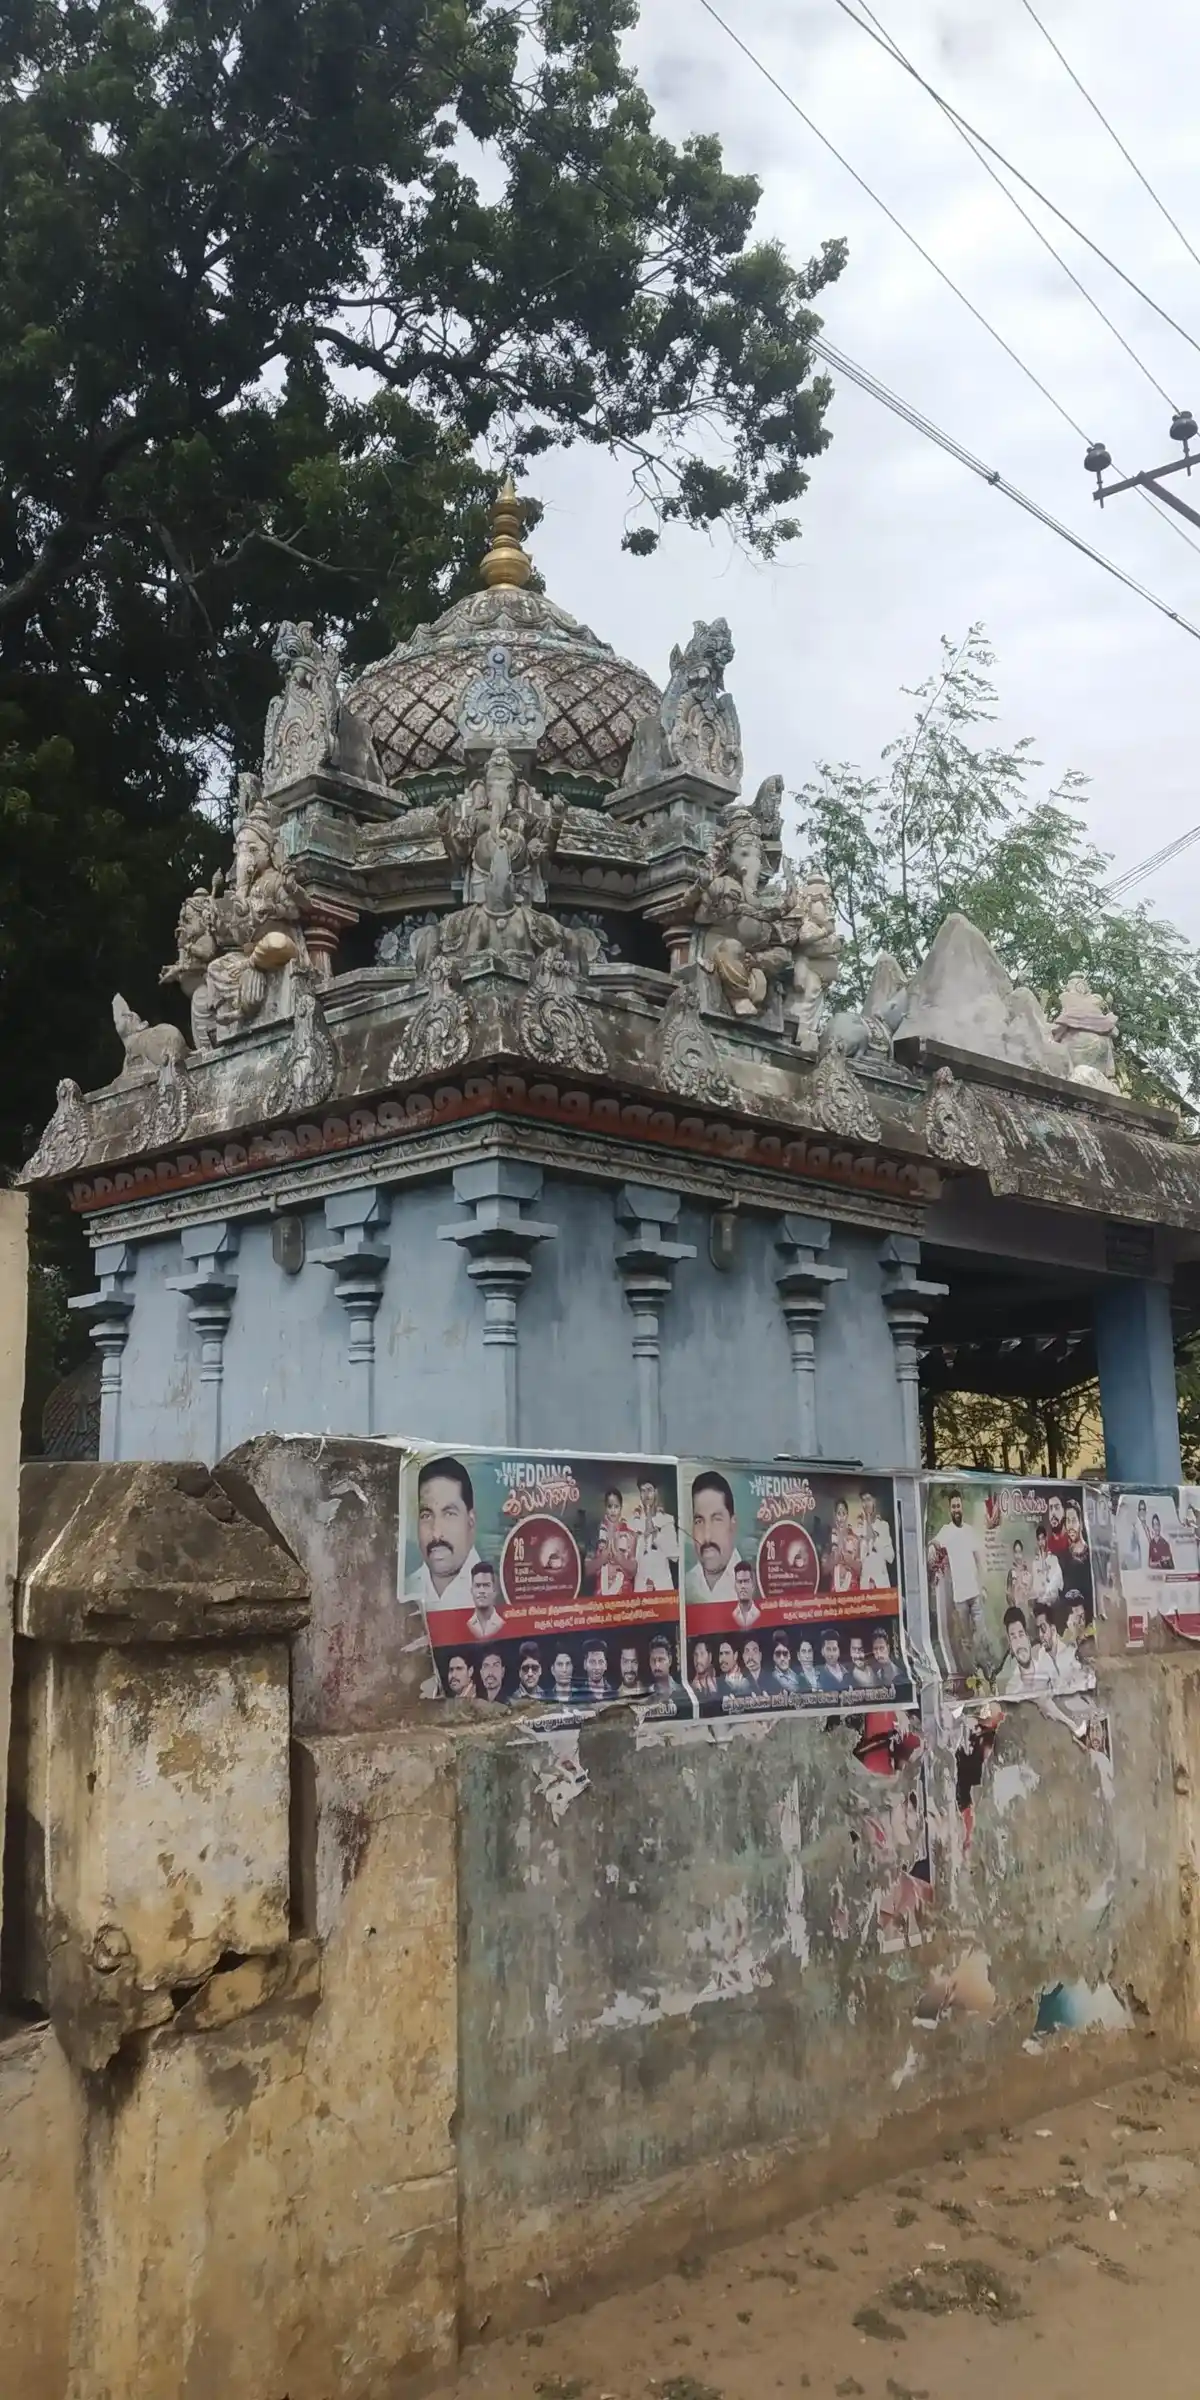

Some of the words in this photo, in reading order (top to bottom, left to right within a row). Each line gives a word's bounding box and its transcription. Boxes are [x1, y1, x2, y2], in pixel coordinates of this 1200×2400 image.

[501, 1461, 573, 1488] WEDDING
[756, 1475, 811, 1497] WEDDING
[513, 1537, 525, 1561] 26
[766, 1540, 776, 1561] 26
